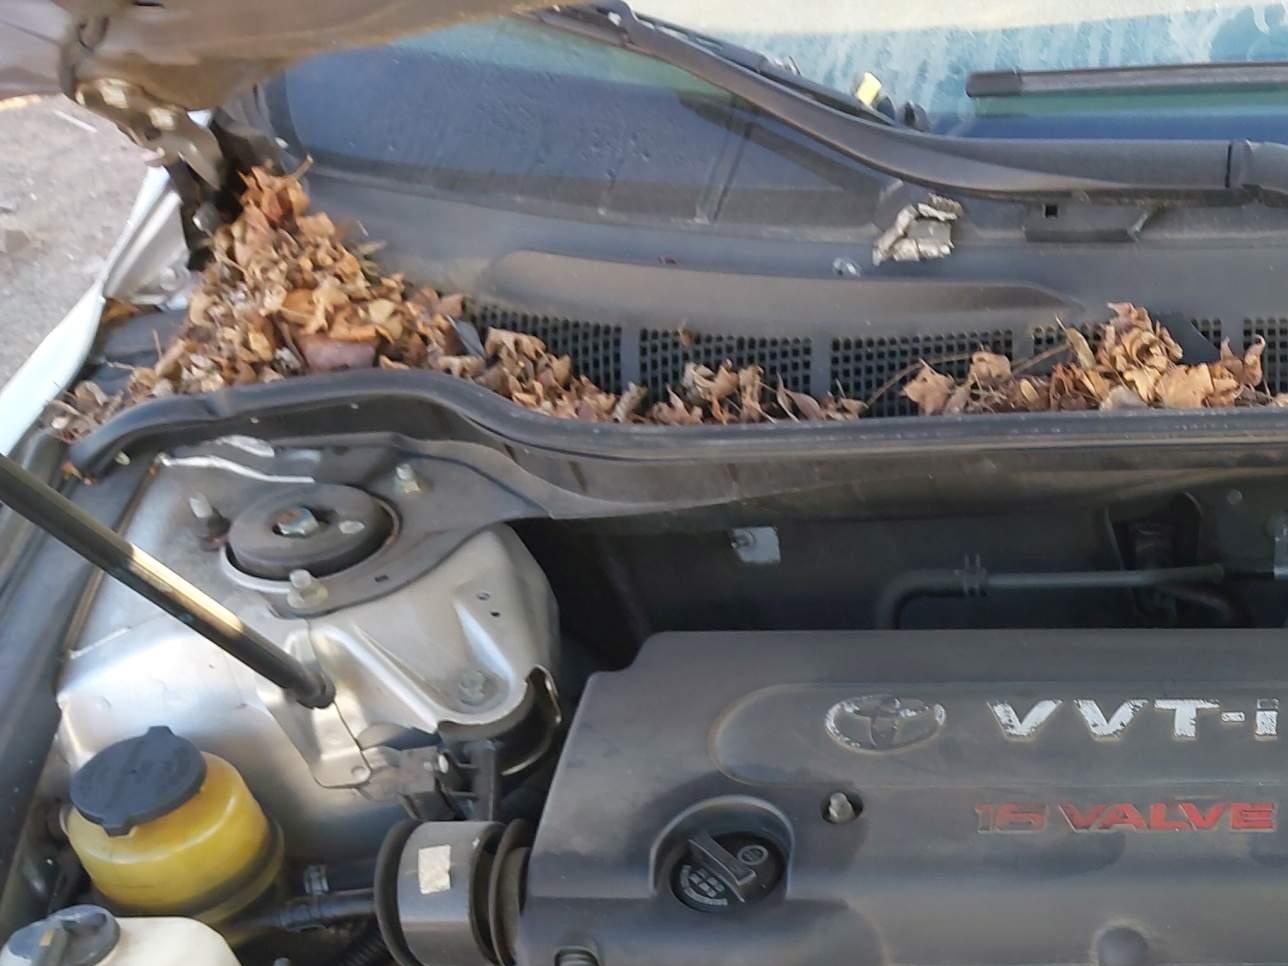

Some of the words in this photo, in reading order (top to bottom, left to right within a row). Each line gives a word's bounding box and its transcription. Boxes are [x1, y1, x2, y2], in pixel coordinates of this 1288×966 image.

[986, 698, 1280, 741] VVT-i
[975, 803, 1049, 833] 16
[1059, 801, 1277, 833] VALVE
